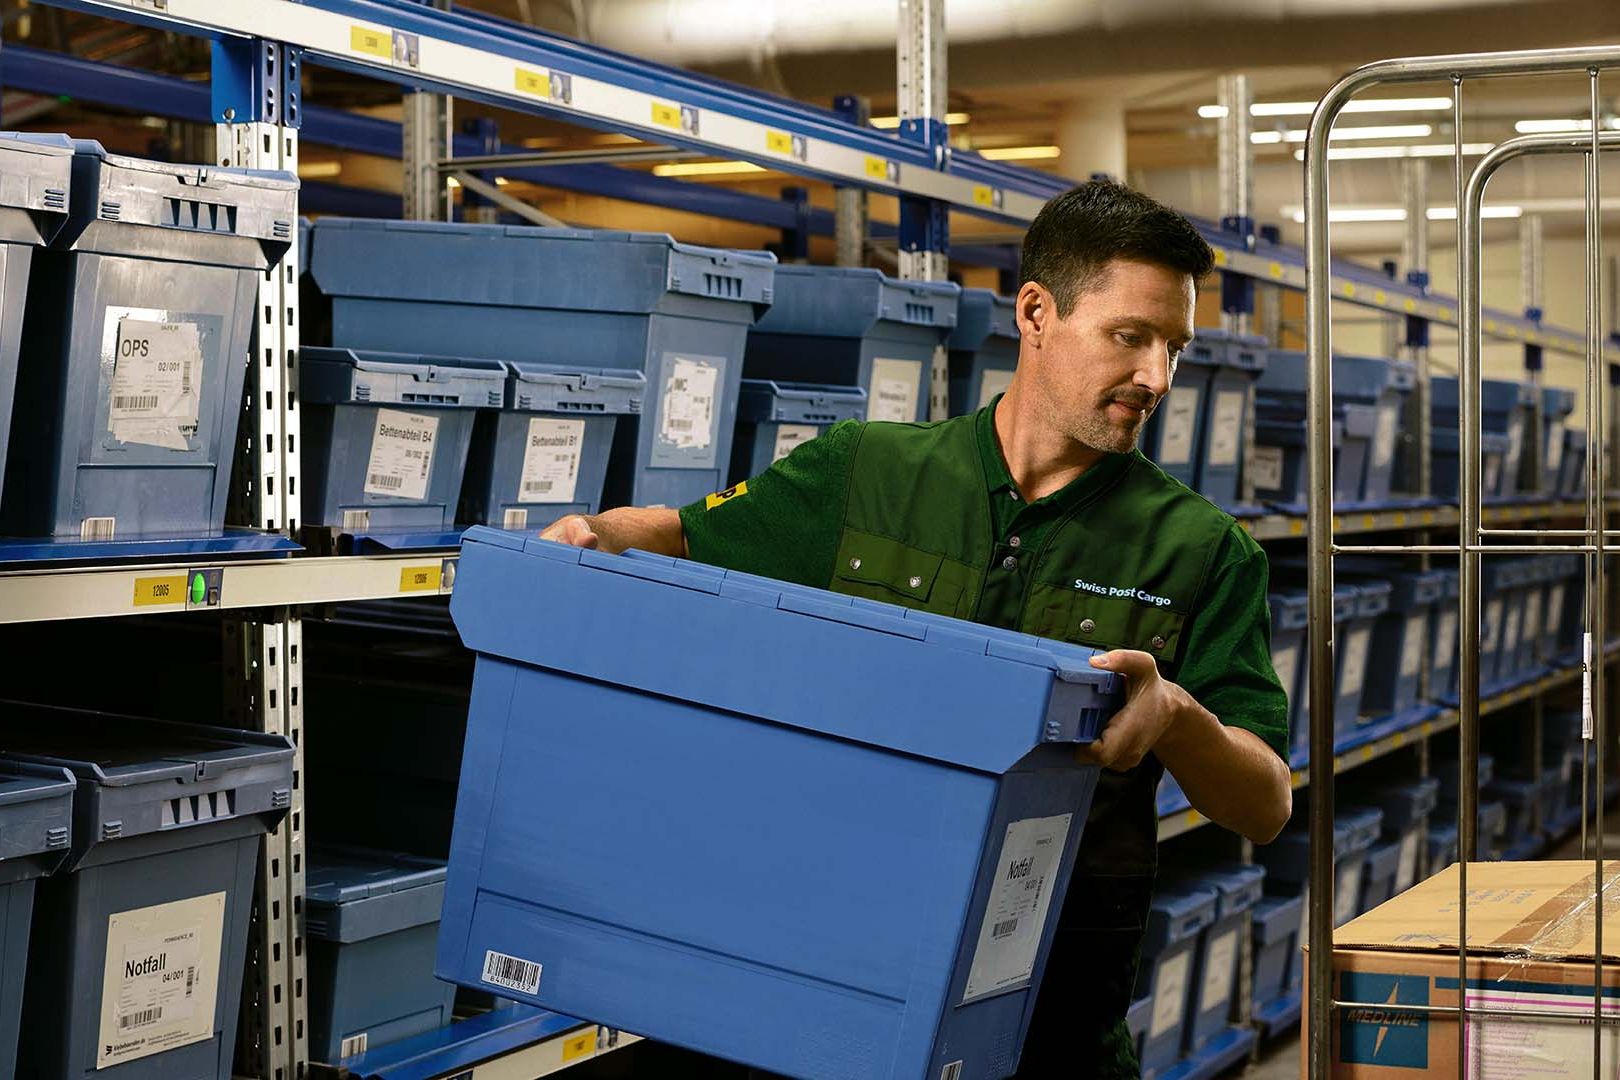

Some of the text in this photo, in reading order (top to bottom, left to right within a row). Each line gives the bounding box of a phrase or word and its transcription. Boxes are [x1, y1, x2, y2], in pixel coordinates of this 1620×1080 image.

[121, 339, 149, 357] OPS
[379, 423, 433, 442] Bettenabteil B4
[152, 584, 170, 597] 12005
[1074, 579, 1171, 606] Swiss Post Cargo
[1007, 856, 1035, 881] Notfall
[125, 953, 166, 978] Notfall
[1347, 1009, 1419, 1026] MEDLINE
